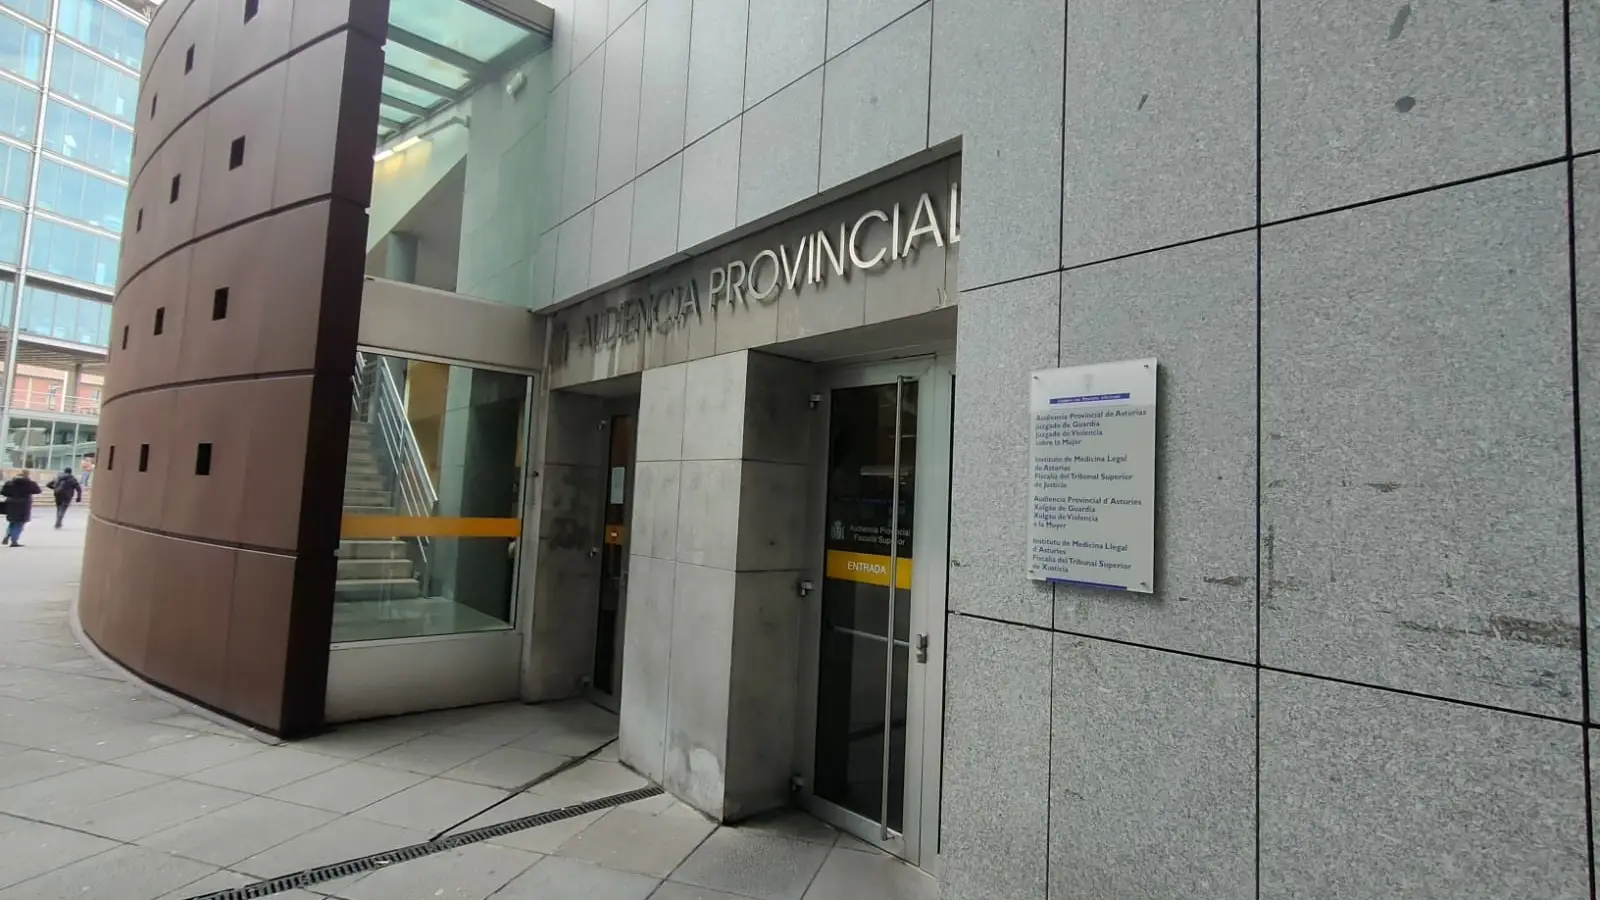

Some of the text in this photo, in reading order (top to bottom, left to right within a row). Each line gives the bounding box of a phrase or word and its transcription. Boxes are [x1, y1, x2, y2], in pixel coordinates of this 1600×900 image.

[580, 182, 961, 351] AUDIENCIA PROVINCIAL
[1036, 409, 1147, 422] Audiencia Provincial de Asturias
[1035, 422, 1060, 431] Juzgado
[1072, 420, 1100, 428] Guardia
[1035, 431, 1060, 439] Juzgado
[1070, 429, 1103, 437] Violencia
[1062, 439, 1082, 448] Mujer
[1107, 454, 1128, 464] Legal
[1100, 473, 1133, 481] Superior
[1043, 481, 1067, 489] Justicia
[1034, 495, 1066, 503] Audiencia
[1067, 496, 1102, 504] Provincial
[1068, 505, 1096, 513] Guardia
[1067, 513, 1099, 522] Violencia
[1046, 521, 1067, 530] Muyer
[1072, 540, 1103, 549] Medicina
[1105, 542, 1128, 553] Llegal
[847, 561, 887, 575] ENTRADA
[1041, 563, 1069, 573] Xusticia
[1057, 556, 1068, 564] del
[1068, 557, 1097, 567] Tribunal
[1099, 560, 1132, 570] Superior
